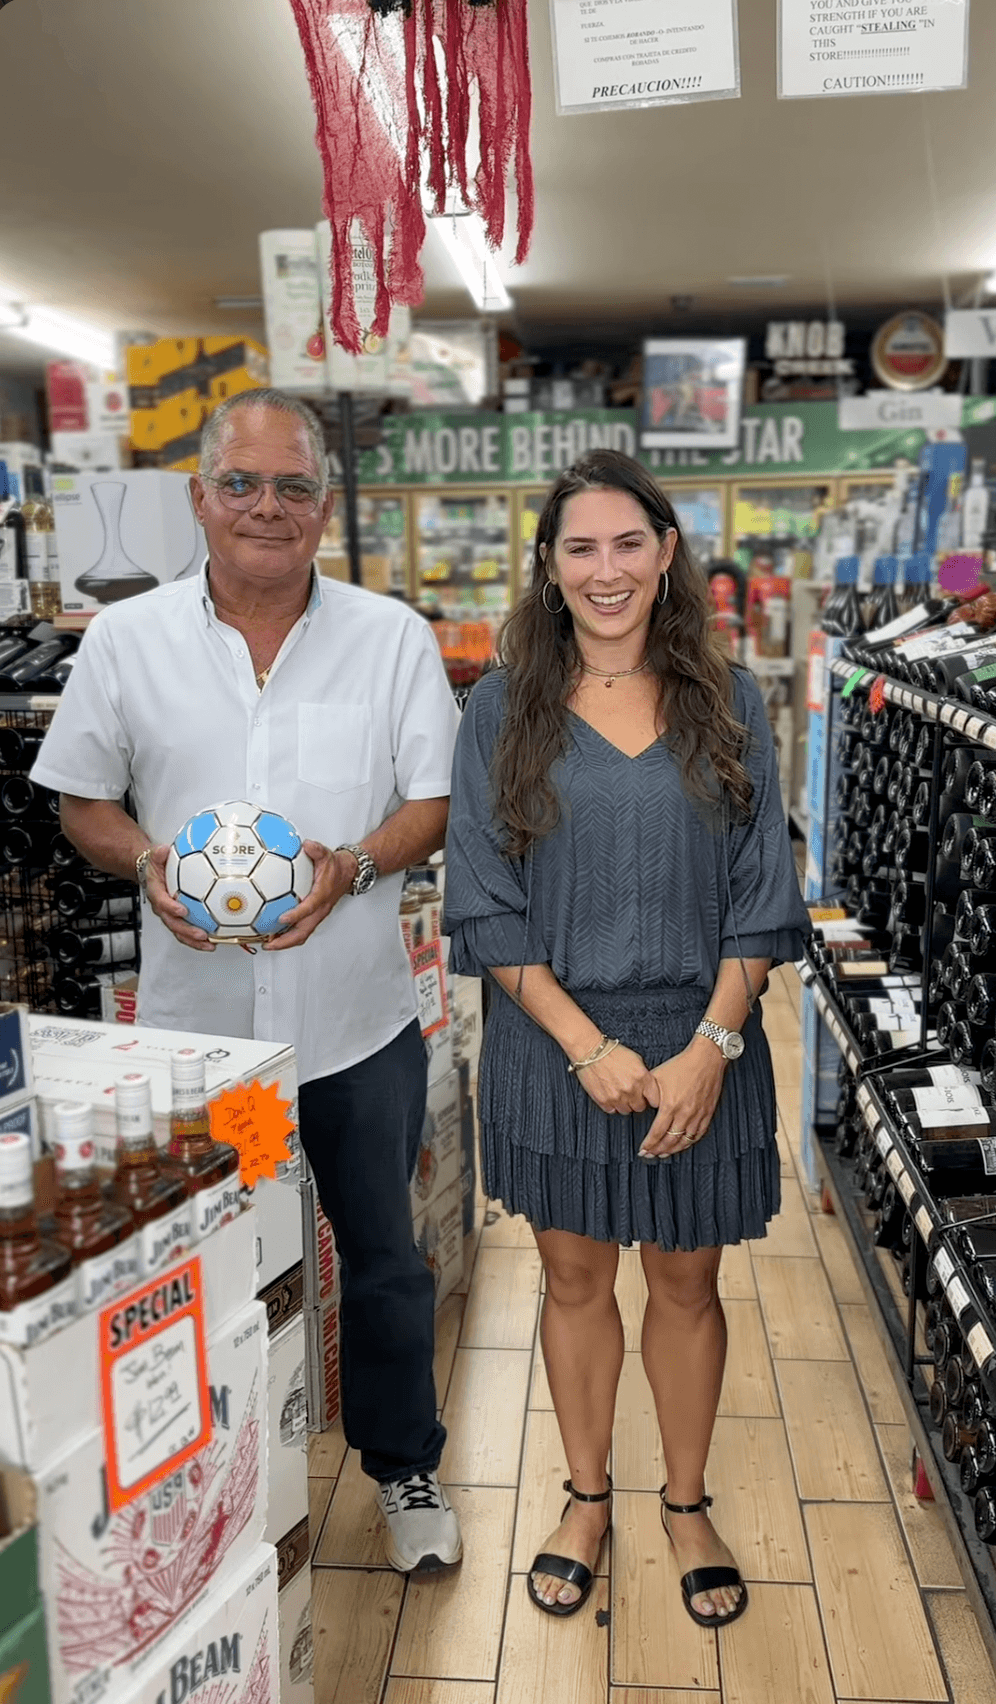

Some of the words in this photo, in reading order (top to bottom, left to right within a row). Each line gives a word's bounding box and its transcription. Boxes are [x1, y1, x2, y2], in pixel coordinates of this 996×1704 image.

[810, 0, 833, 9] YOU
[810, 10, 866, 22] STRENGTH
[868, 10, 878, 19] IF
[881, 8, 903, 18] YOU
[906, 6, 928, 16] ARE
[666, 24, 705, 33] INTENTANDO
[809, 25, 854, 36] CAUGHT
[812, 38, 836, 48] THIS
[592, 76, 702, 98] PRECAUCION!!!!
[877, 401, 923, 422] Gin
[403, 427, 500, 473] MORE
[511, 419, 636, 472] BEHIND
[413, 947, 439, 971] SPECIAL
[200, 1200, 222, 1231] JIM
[317, 1221, 335, 1301] CAMPO
[110, 1271, 195, 1349] SPECIAL
[323, 1343, 340, 1422] CAMPO
[170, 1632, 241, 1704] BEAM
